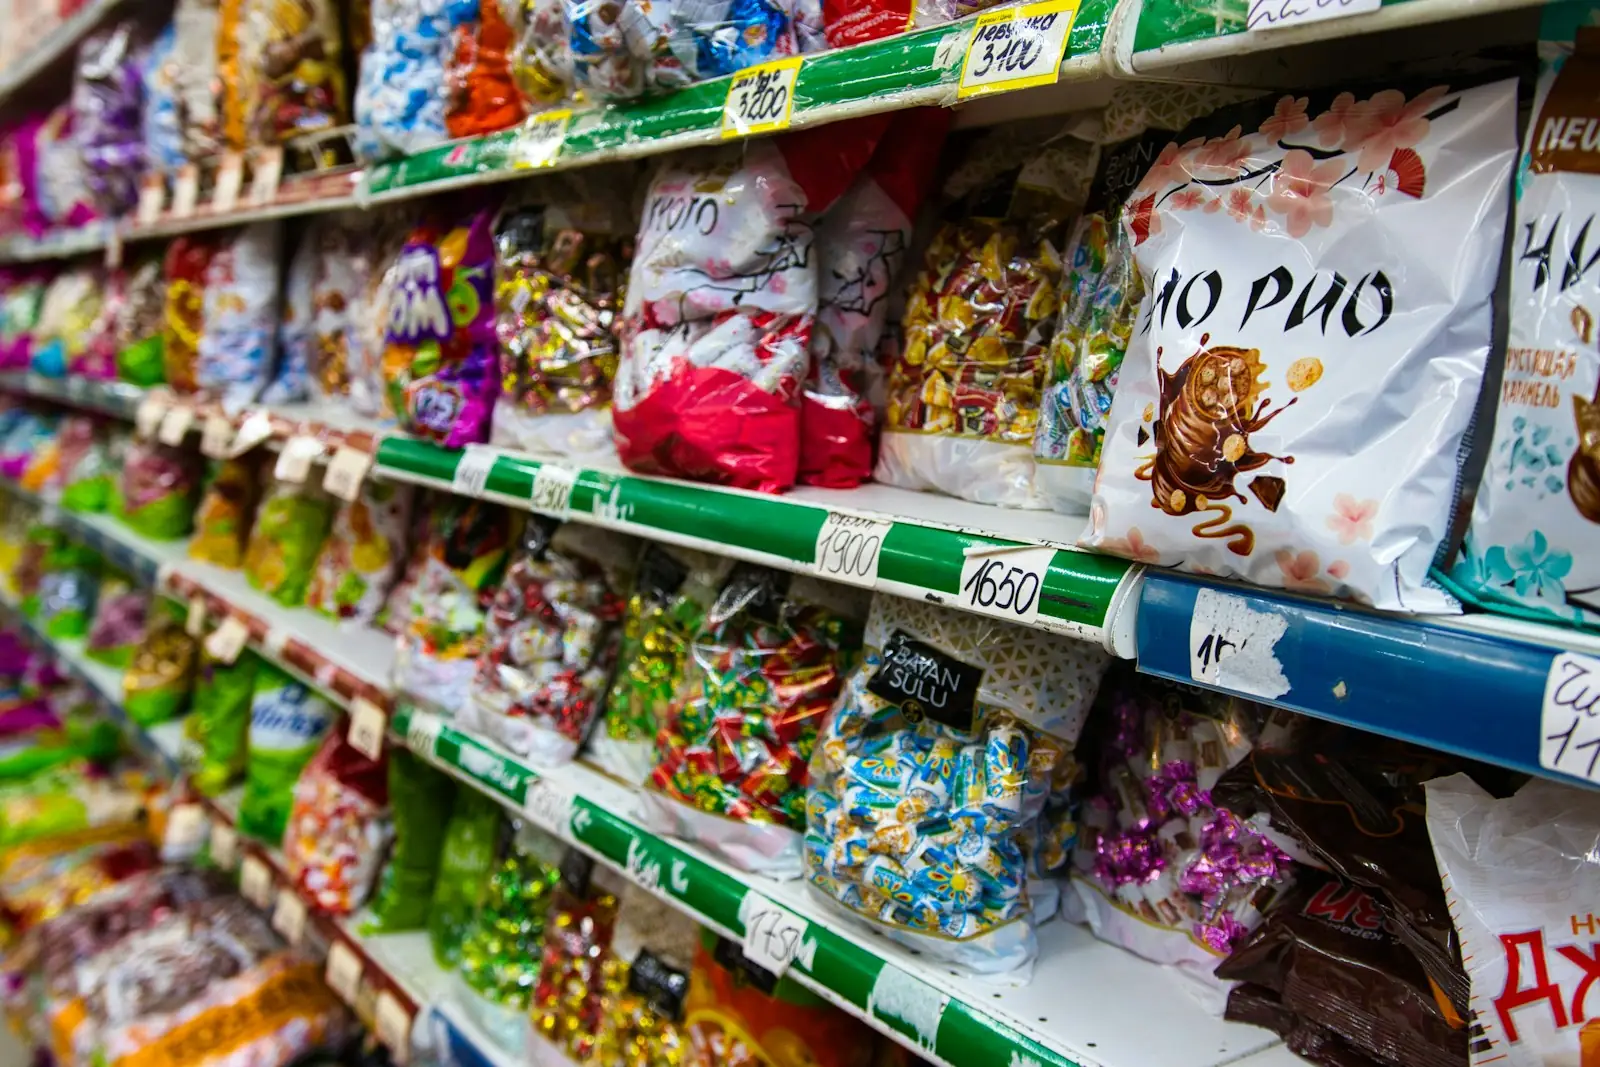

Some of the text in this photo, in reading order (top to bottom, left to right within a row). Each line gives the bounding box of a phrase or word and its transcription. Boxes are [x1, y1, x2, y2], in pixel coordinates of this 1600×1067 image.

[974, 34, 1044, 77] 3100
[740, 85, 787, 120] 3200
[819, 527, 880, 577] 1900
[964, 558, 1039, 614] 1650
[889, 667, 948, 708] SULU
[892, 645, 960, 692] BAYAN
[1571, 912, 1600, 936] Н
